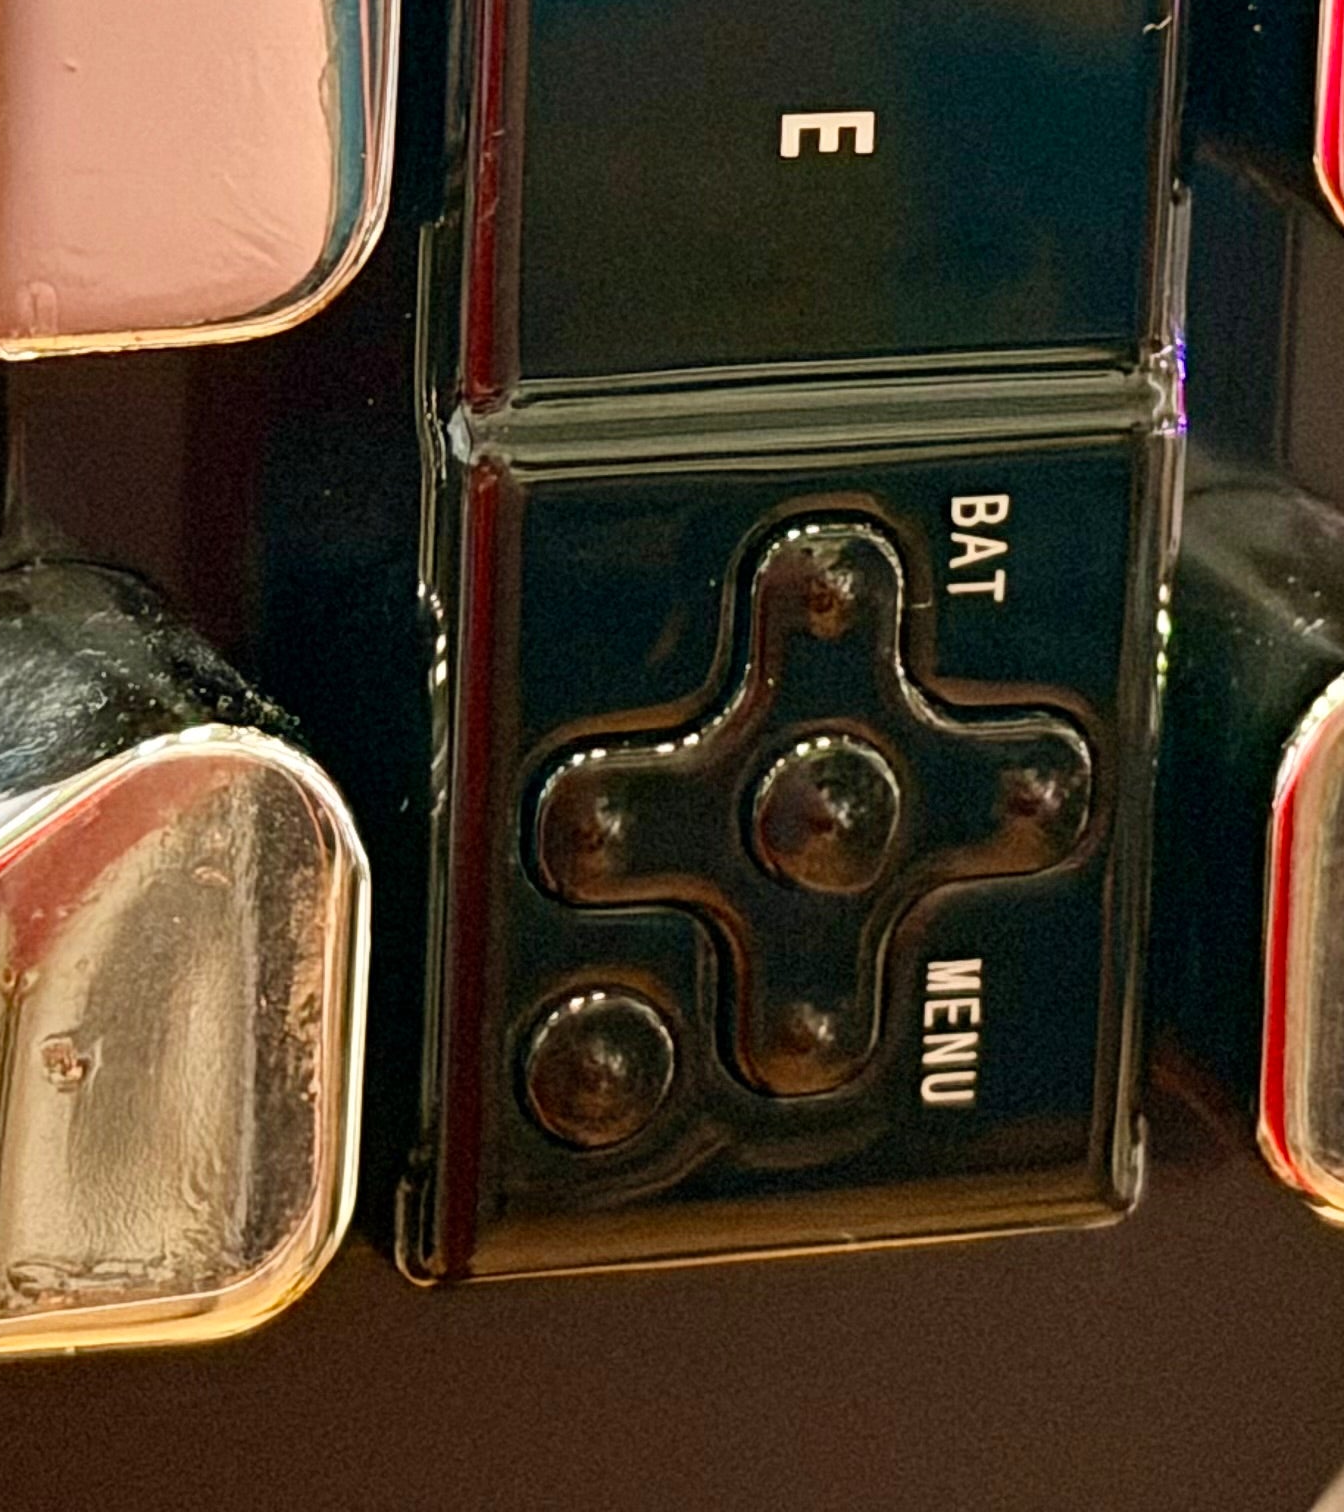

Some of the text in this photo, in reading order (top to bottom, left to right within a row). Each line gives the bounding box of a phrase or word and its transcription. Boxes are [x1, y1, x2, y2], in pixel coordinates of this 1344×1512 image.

[780, 111, 875, 158] E
[947, 494, 1010, 602] BAT
[920, 958, 982, 1103] MENU
